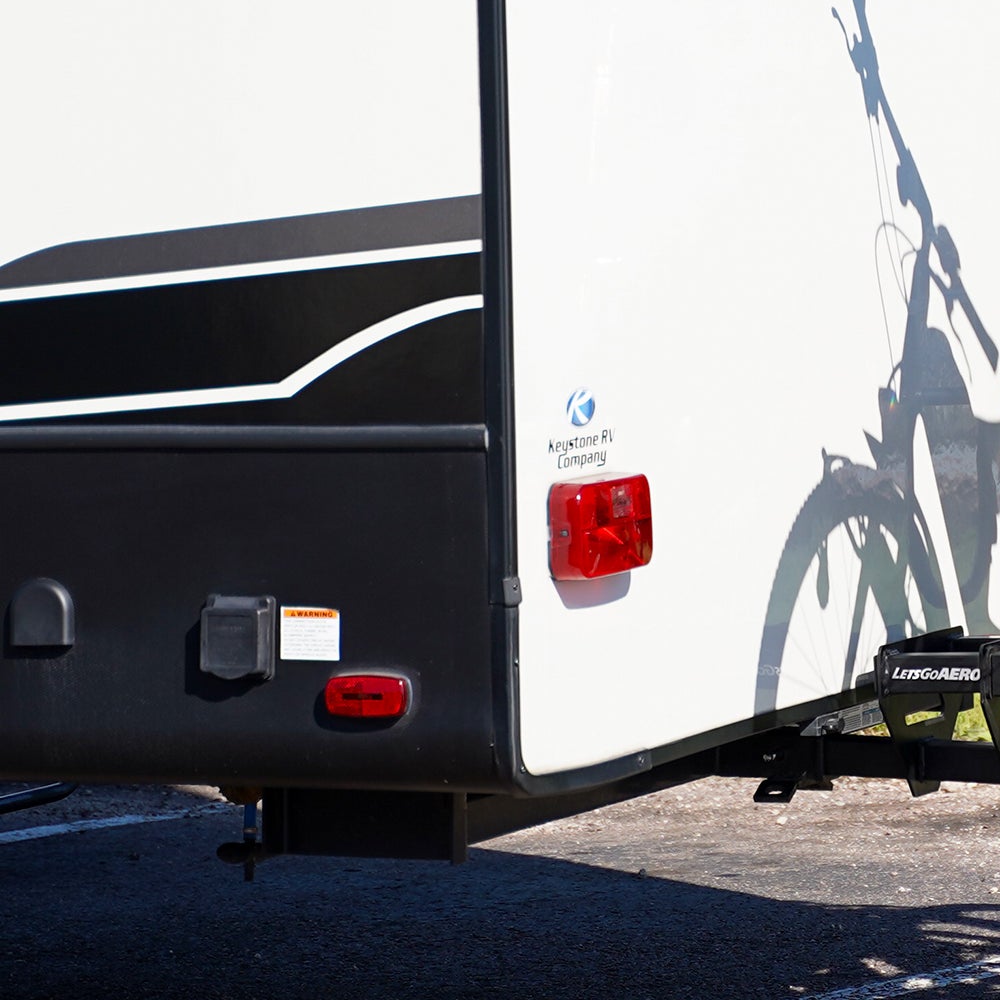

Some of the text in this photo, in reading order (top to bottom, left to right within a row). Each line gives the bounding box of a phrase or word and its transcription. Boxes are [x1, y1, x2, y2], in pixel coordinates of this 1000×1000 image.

[549, 428, 616, 456] Keystone RV
[558, 450, 607, 469] Company
